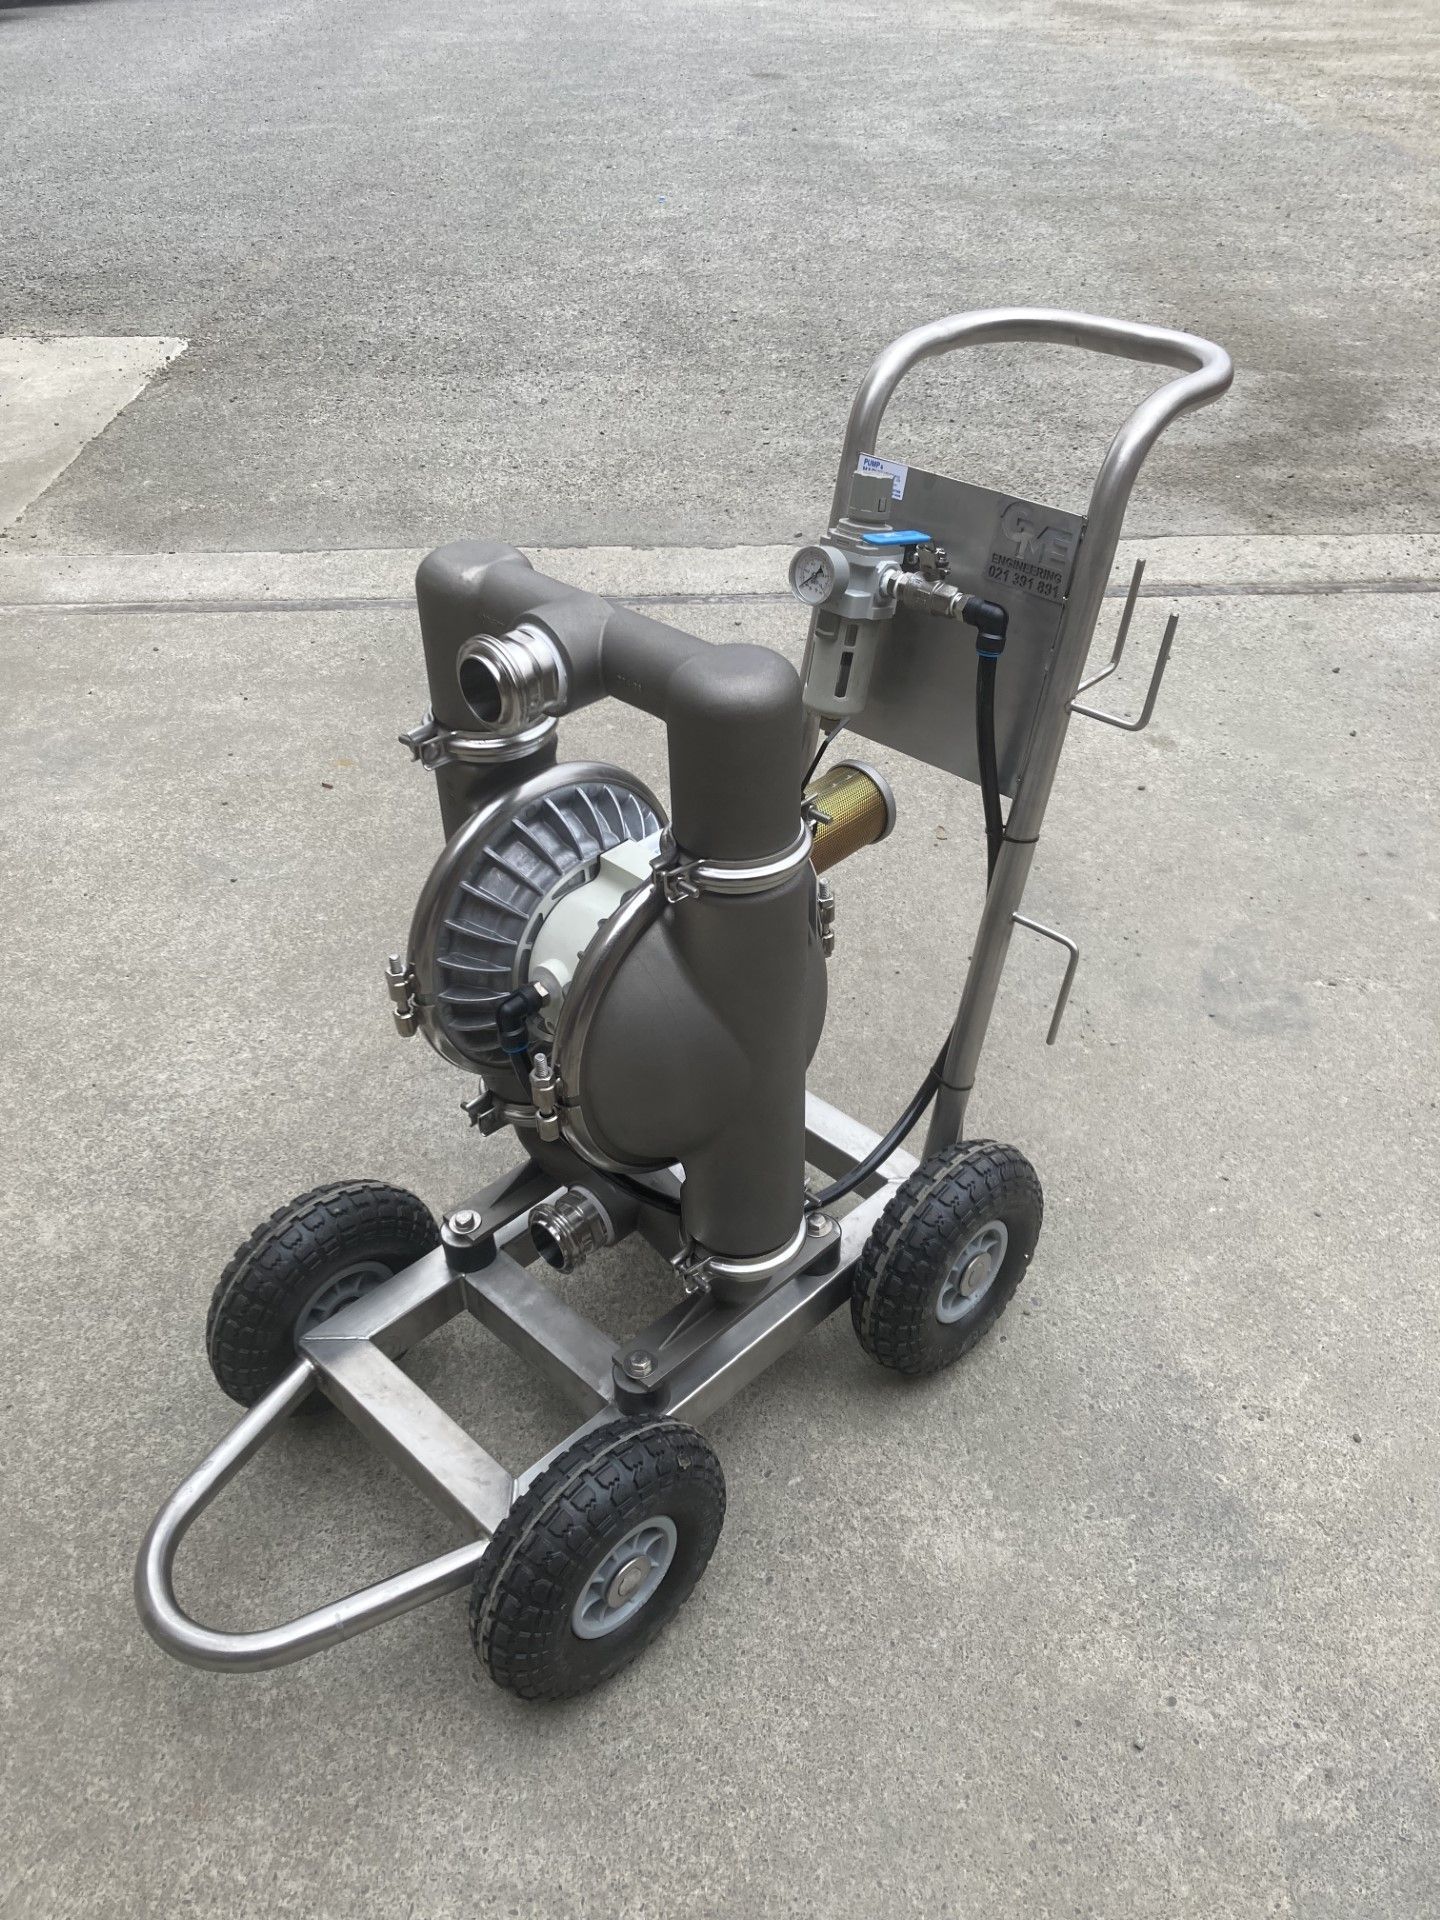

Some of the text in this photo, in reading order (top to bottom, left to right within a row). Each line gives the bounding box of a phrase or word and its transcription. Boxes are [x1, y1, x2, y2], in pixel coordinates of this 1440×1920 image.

[989, 566, 1009, 582] 021
[1013, 573, 1034, 590] 391
[992, 553, 1062, 583] ENGINEERING
